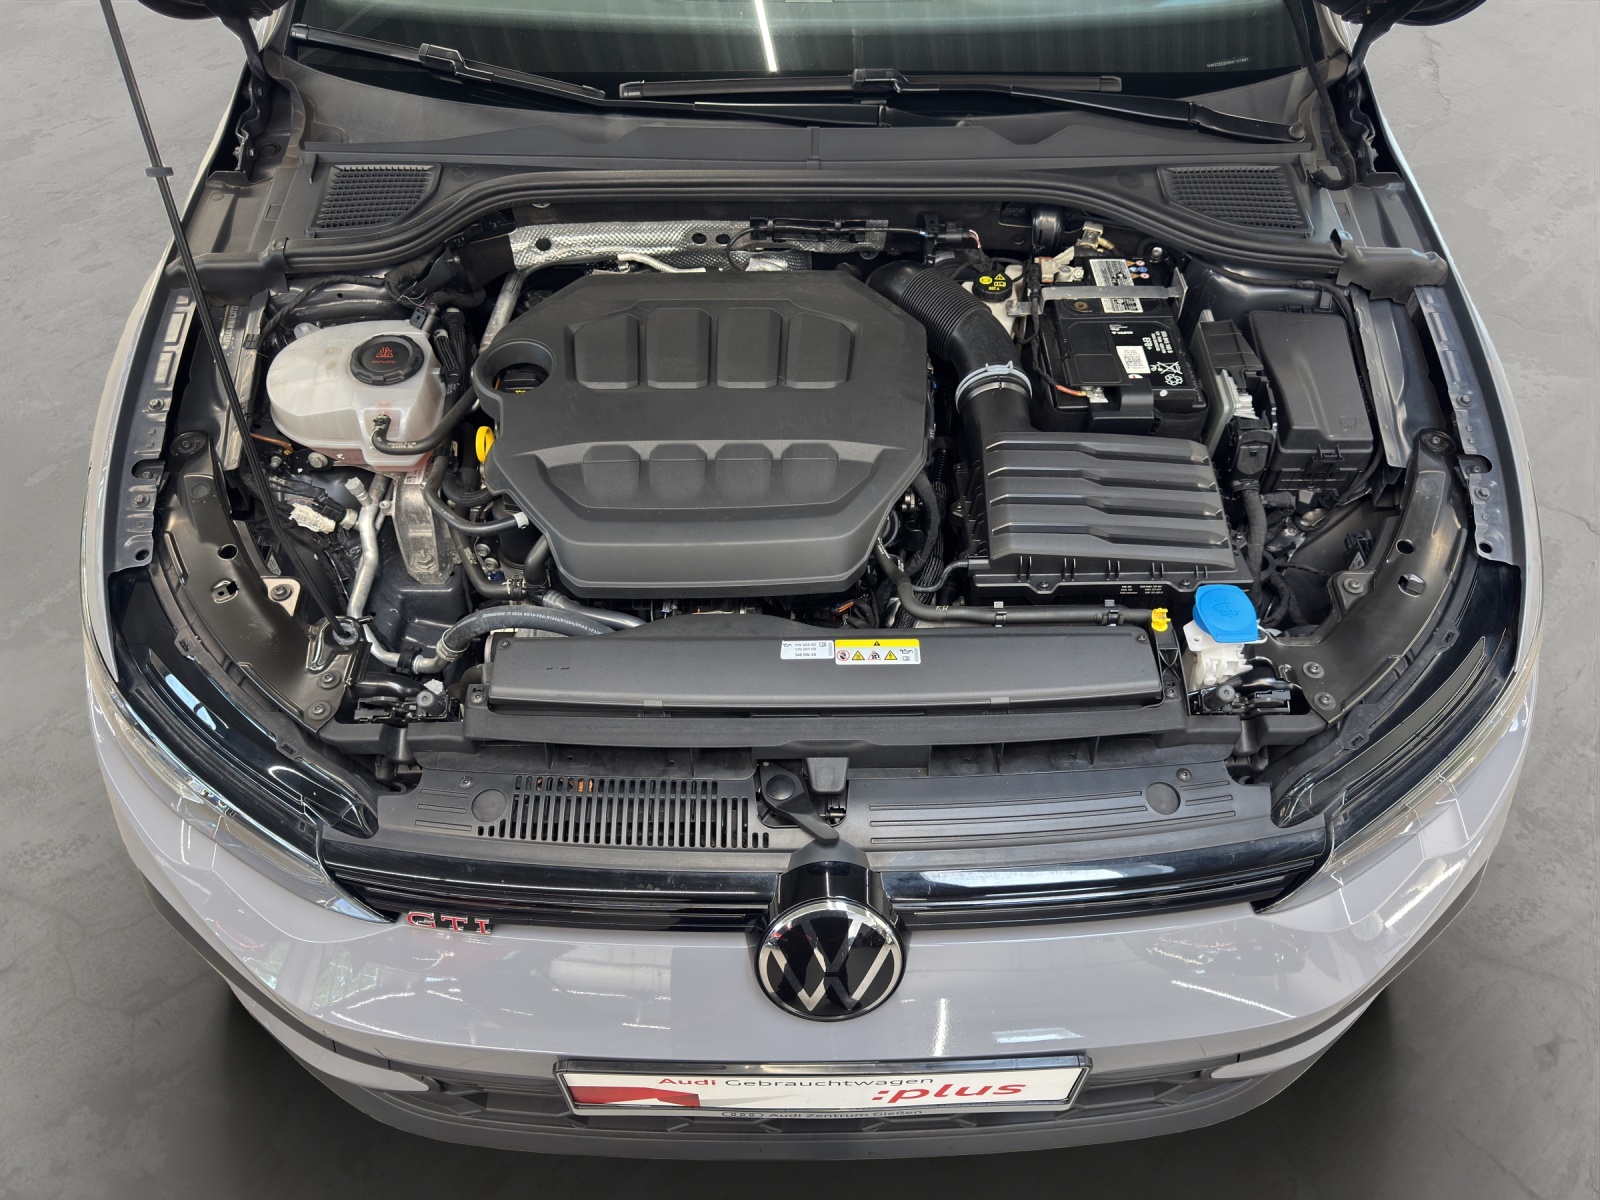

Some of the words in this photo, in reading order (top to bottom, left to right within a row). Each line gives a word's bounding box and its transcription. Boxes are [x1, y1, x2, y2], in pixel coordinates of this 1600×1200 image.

[406, 911, 492, 934] GTI
[762, 908, 900, 1016] VW
[658, 1078, 717, 1086] Audi
[725, 1076, 934, 1090] Gebrauchtwagen
[872, 1083, 1027, 1104] :plus
